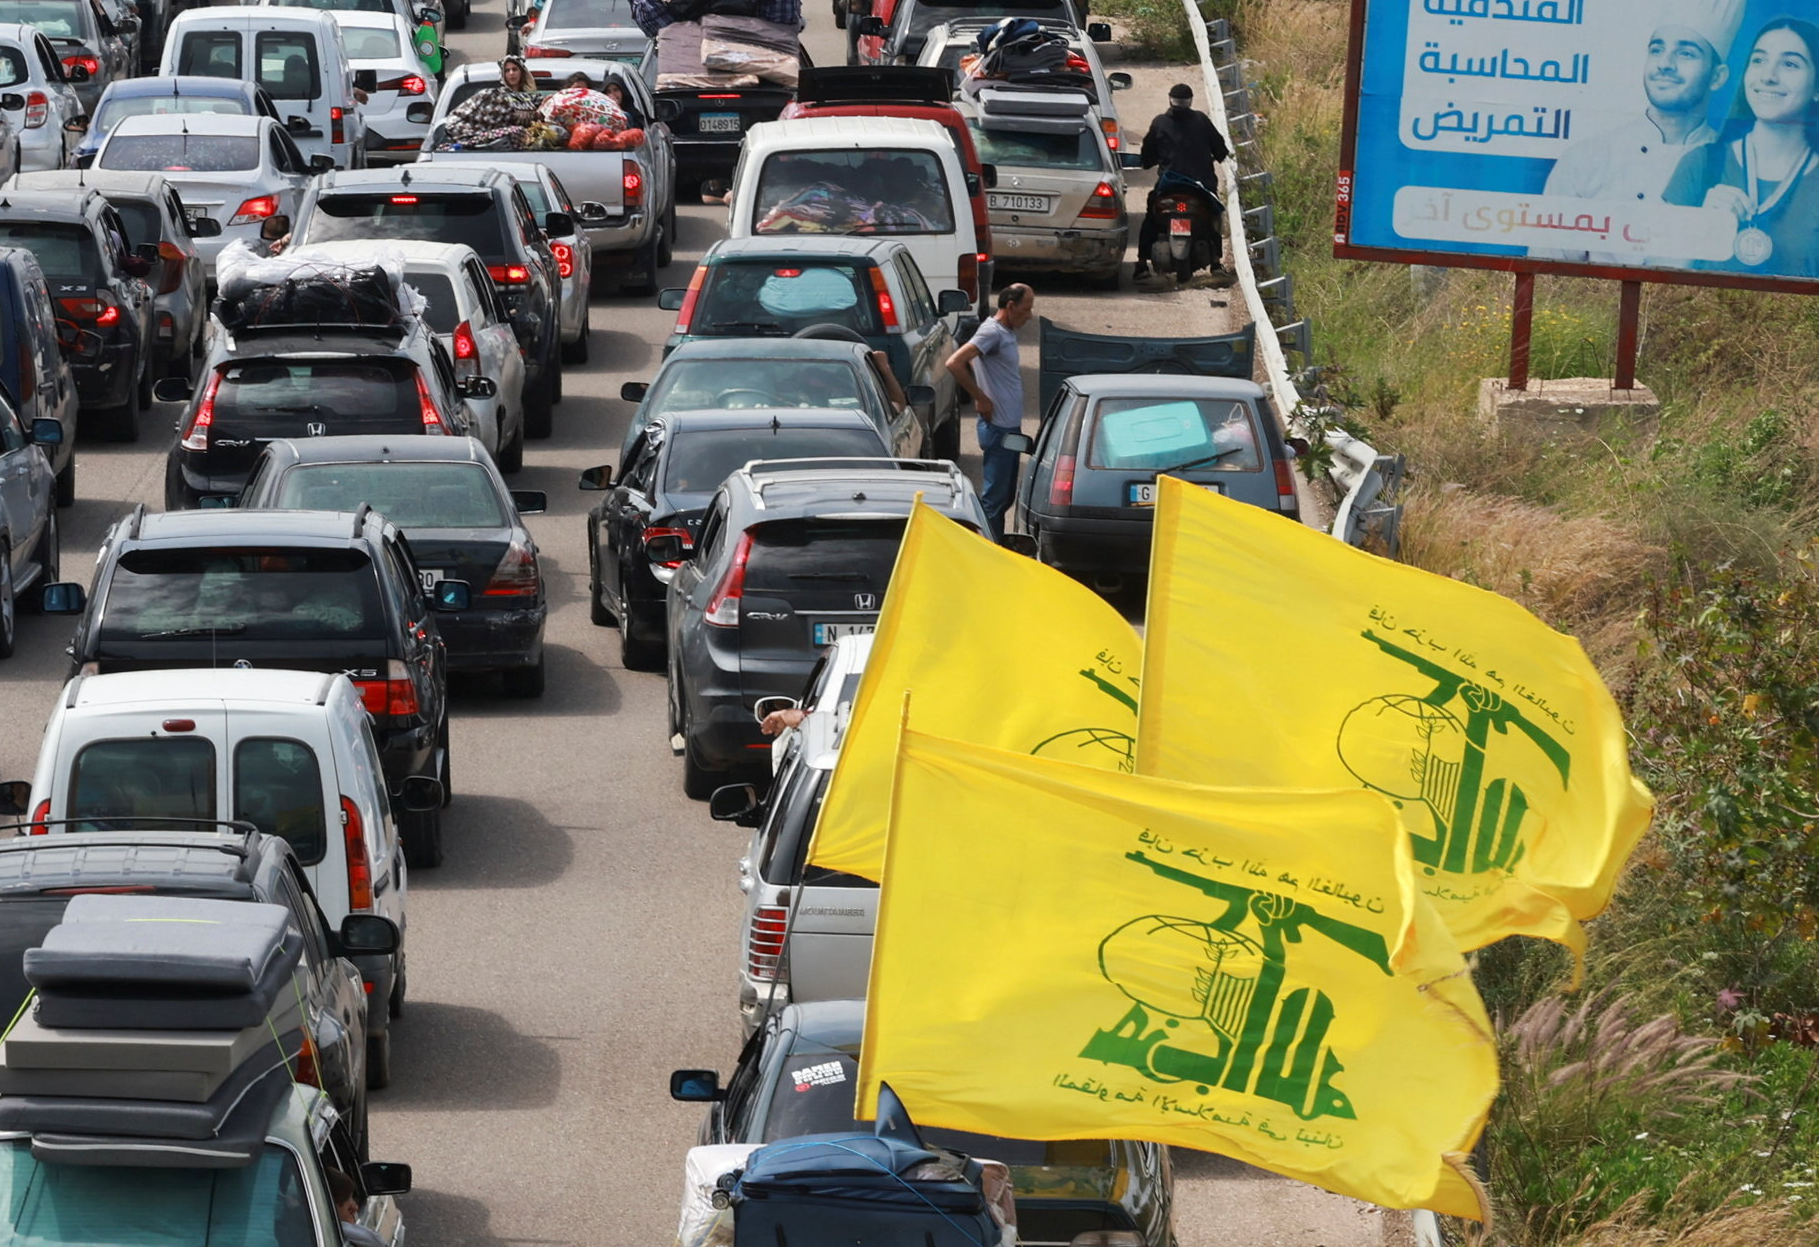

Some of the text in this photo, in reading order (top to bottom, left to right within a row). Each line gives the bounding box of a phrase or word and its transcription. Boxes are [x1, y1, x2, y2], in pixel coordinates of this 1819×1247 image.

[1418, 41, 1590, 85] المحاسبة
[1411, 102, 1571, 143] التمريض
[1002, 196, 1044, 209] 710133
[1337, 176, 1351, 203] 365
